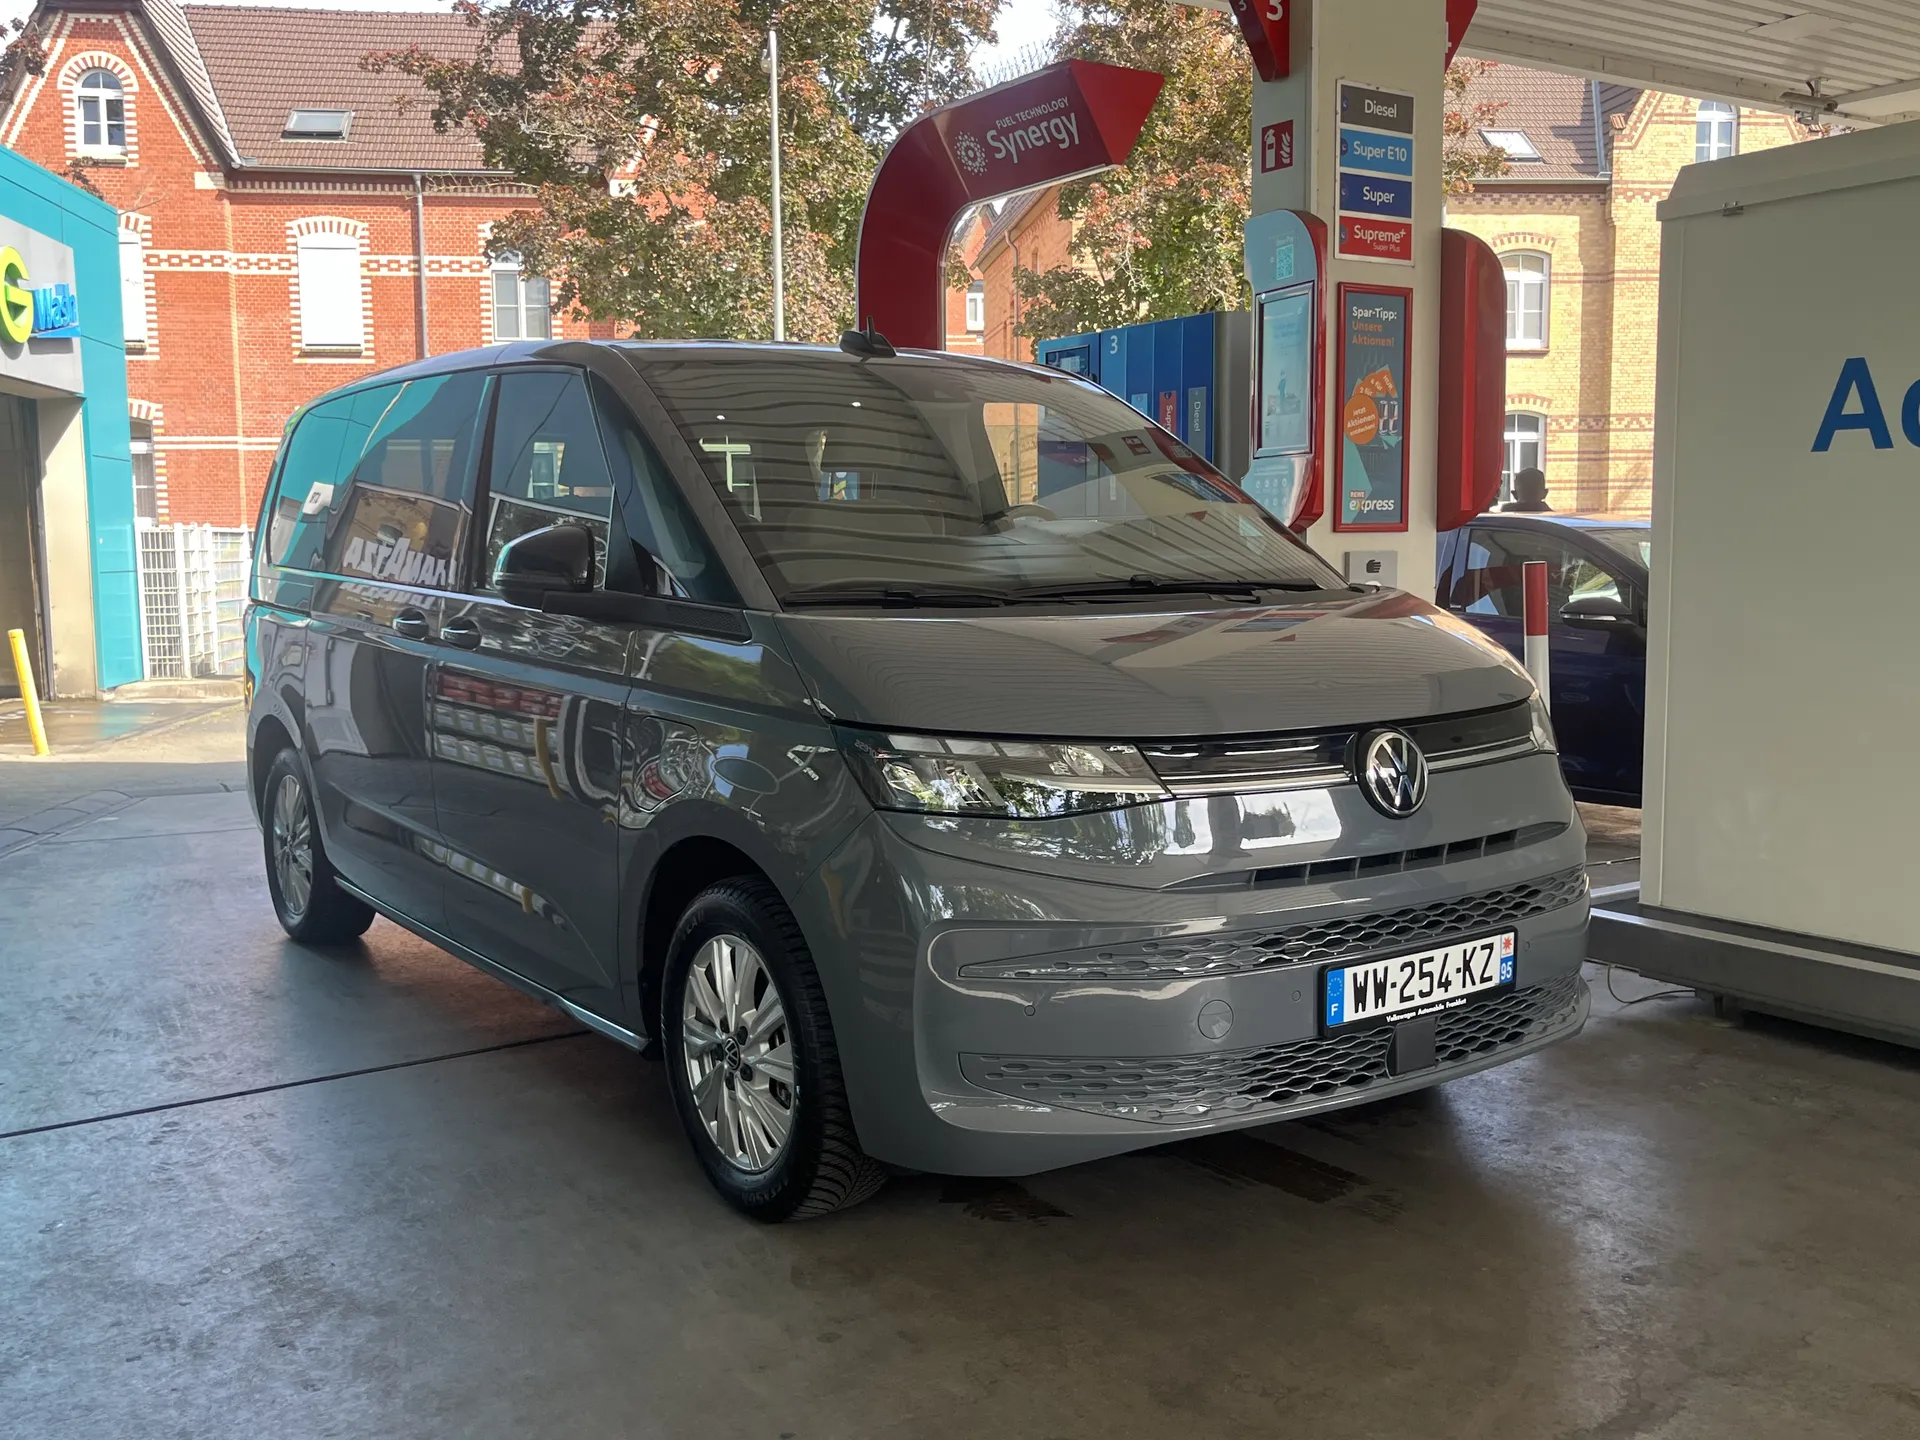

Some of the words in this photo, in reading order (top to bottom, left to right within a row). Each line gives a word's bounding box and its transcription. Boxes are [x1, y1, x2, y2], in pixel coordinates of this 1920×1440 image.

[1266, 0, 1283, 21] 3
[996, 115, 1016, 129] FUEL
[1015, 96, 1069, 122] TECHNOLOGY
[1364, 99, 1397, 118] Diesel
[986, 112, 1080, 164] Synergy
[1353, 140, 1386, 161] Super
[1387, 145, 1408, 162] E10
[1362, 186, 1395, 206] Super
[1372, 242, 1389, 252] Super
[1389, 244, 1401, 252] Plus
[1352, 305, 1398, 321] Spar-Tipp:
[1352, 320, 1383, 332] Unsere
[1110, 335, 1118, 354] 3
[1352, 334, 1394, 348] Aktionen!
[1347, 414, 1376, 428] Aktionen
[1349, 499, 1395, 514] express
[1331, 1003, 1339, 1017] F
[1500, 961, 1513, 980] 95
